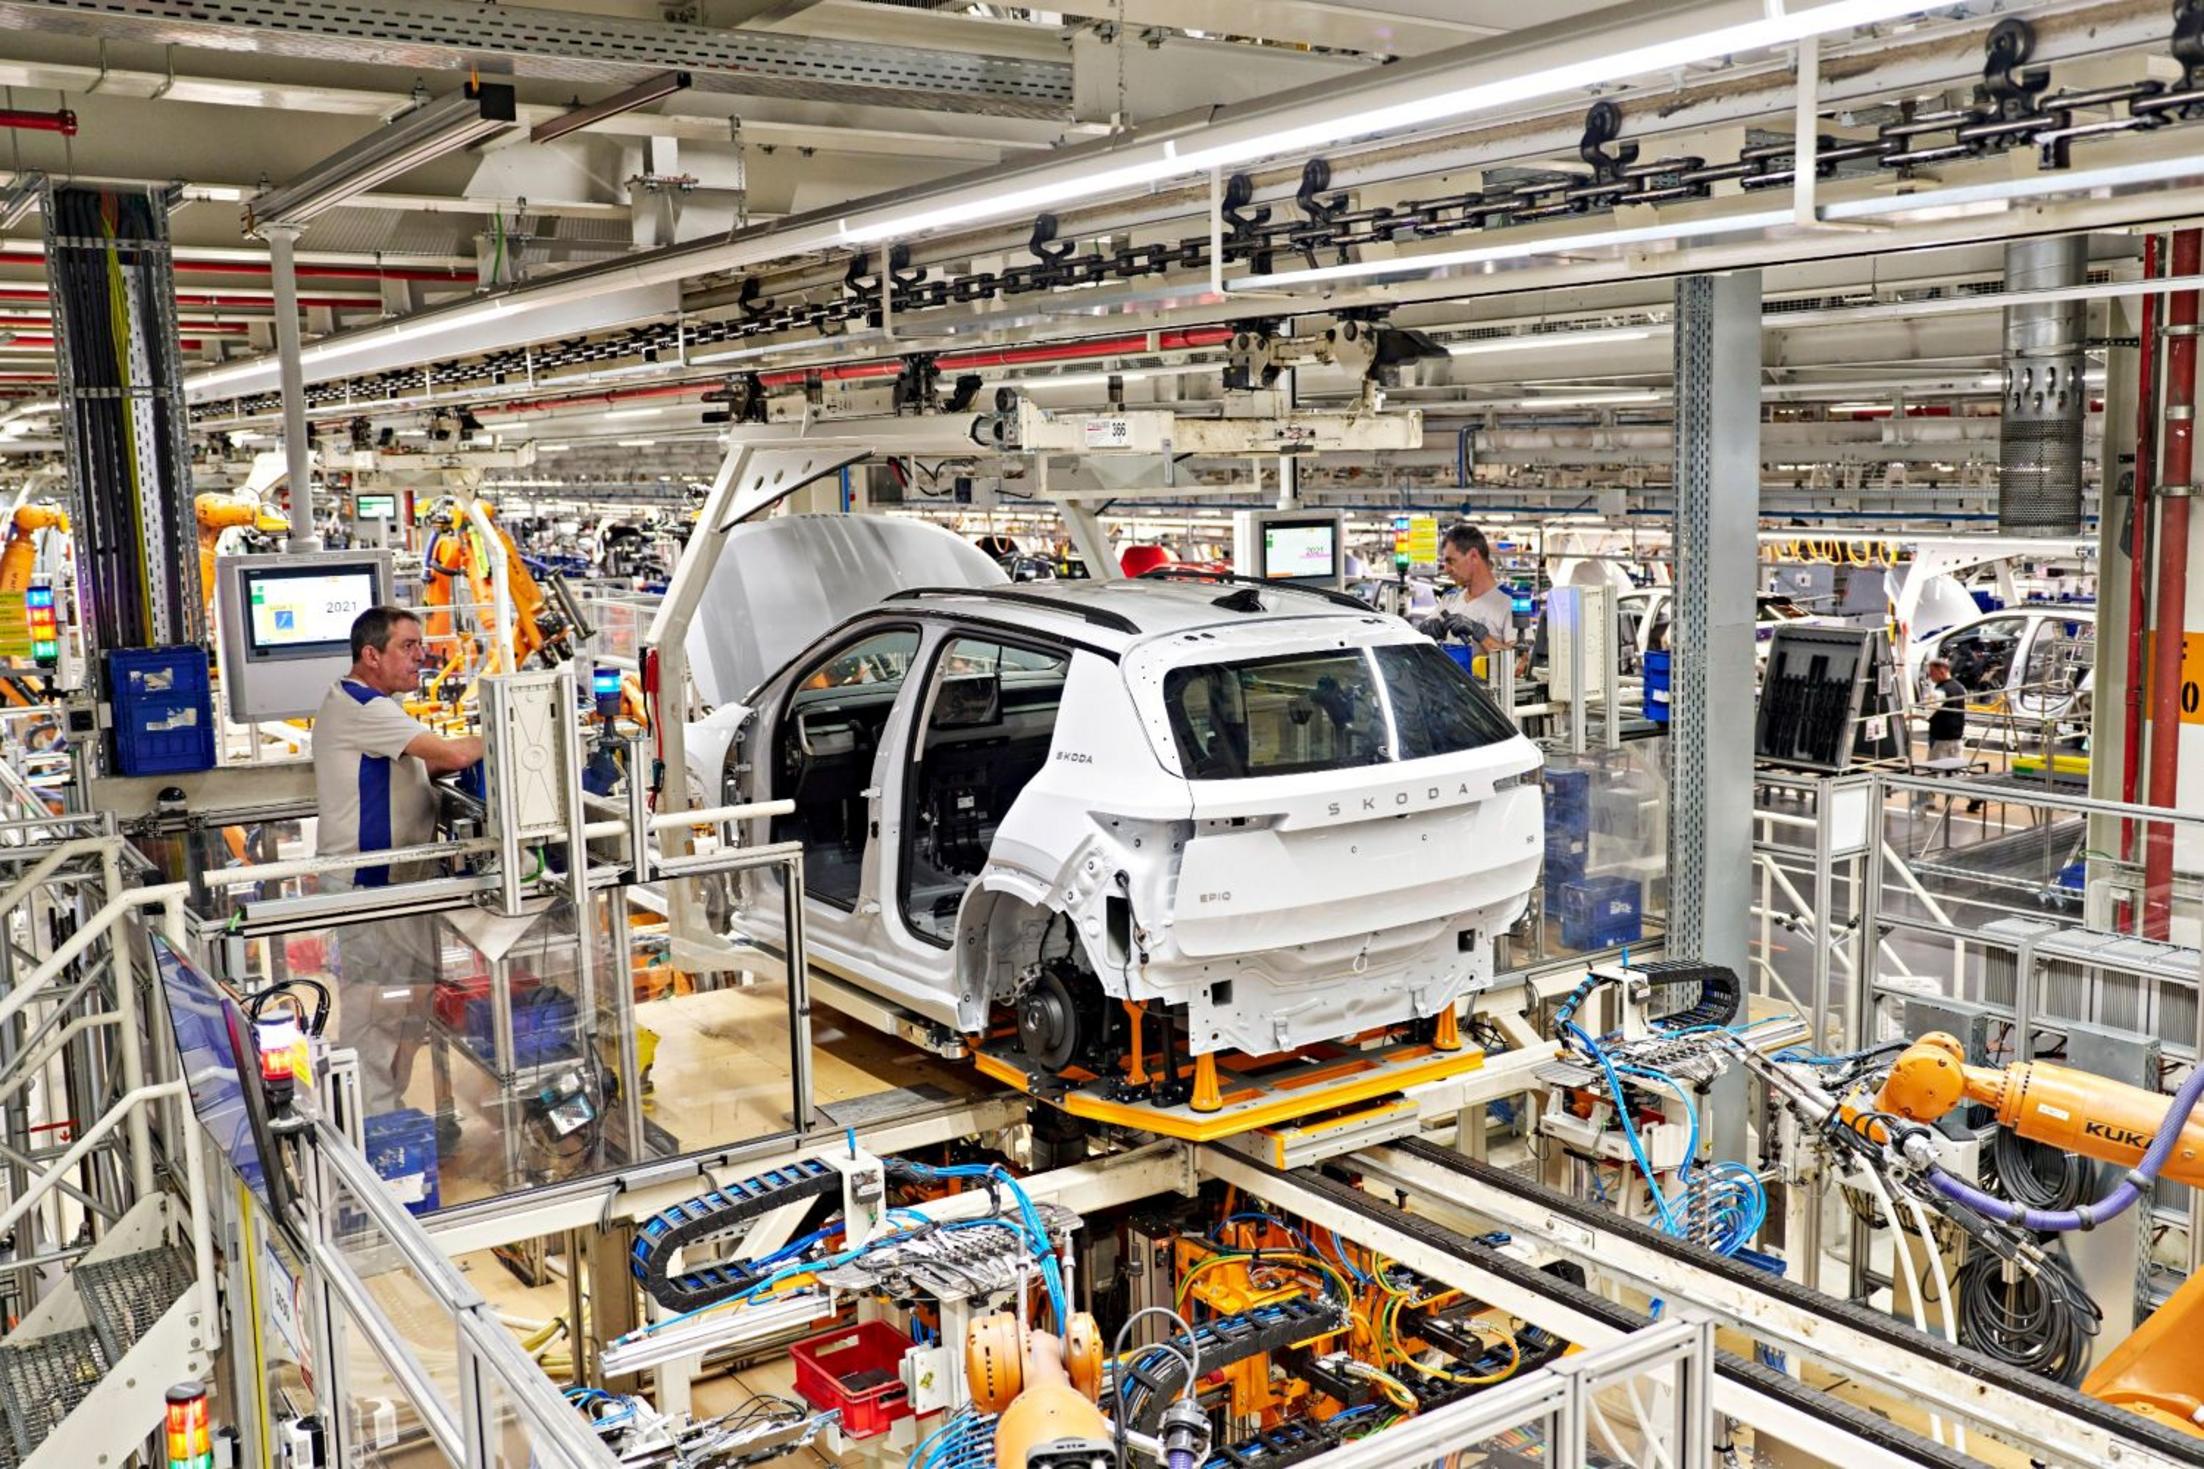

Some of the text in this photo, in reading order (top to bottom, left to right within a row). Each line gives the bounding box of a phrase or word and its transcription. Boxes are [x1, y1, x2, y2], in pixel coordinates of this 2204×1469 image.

[326, 601, 358, 613] 2021
[1056, 751, 1093, 764] SKODA
[1328, 783, 1469, 816] SKODA
[1200, 891, 1231, 903] EPIQ
